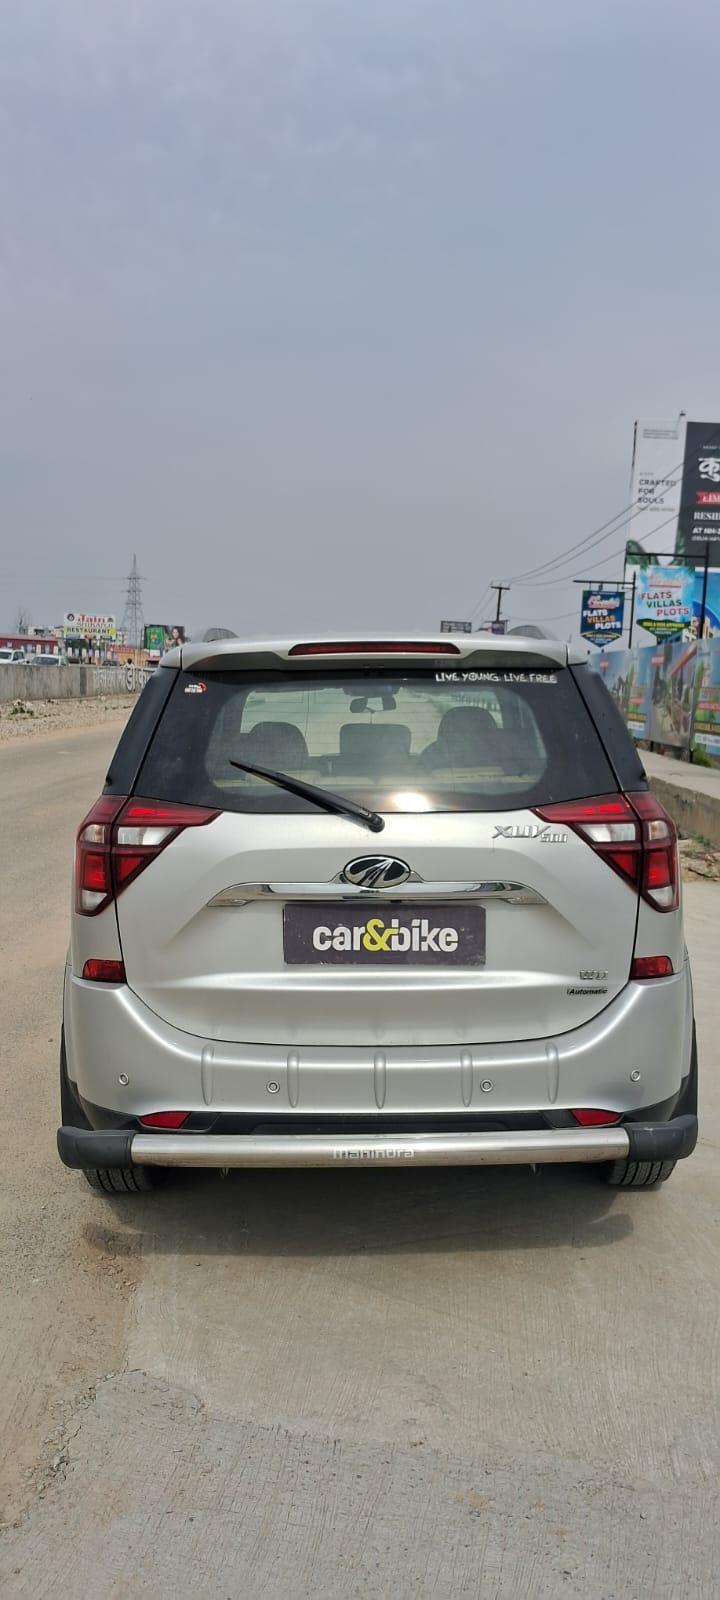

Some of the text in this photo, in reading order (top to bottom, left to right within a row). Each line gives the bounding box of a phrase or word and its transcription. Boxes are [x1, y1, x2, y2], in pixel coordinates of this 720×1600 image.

[639, 479, 677, 487] CRAFTED
[637, 496, 665, 504] SOULS
[692, 527, 702, 535] AT
[641, 591, 672, 600] FLATS
[646, 599, 682, 608] VILLAS
[583, 609, 609, 617] FLATS
[656, 607, 689, 616] PLOTS
[587, 615, 616, 624] VILLAS
[66, 626, 111, 634] RESTAURANT
[595, 621, 621, 630] PLOTS
[435, 672, 558, 683] LIVE YOUNG LIVE FREE
[312, 918, 459, 952] car&bike
